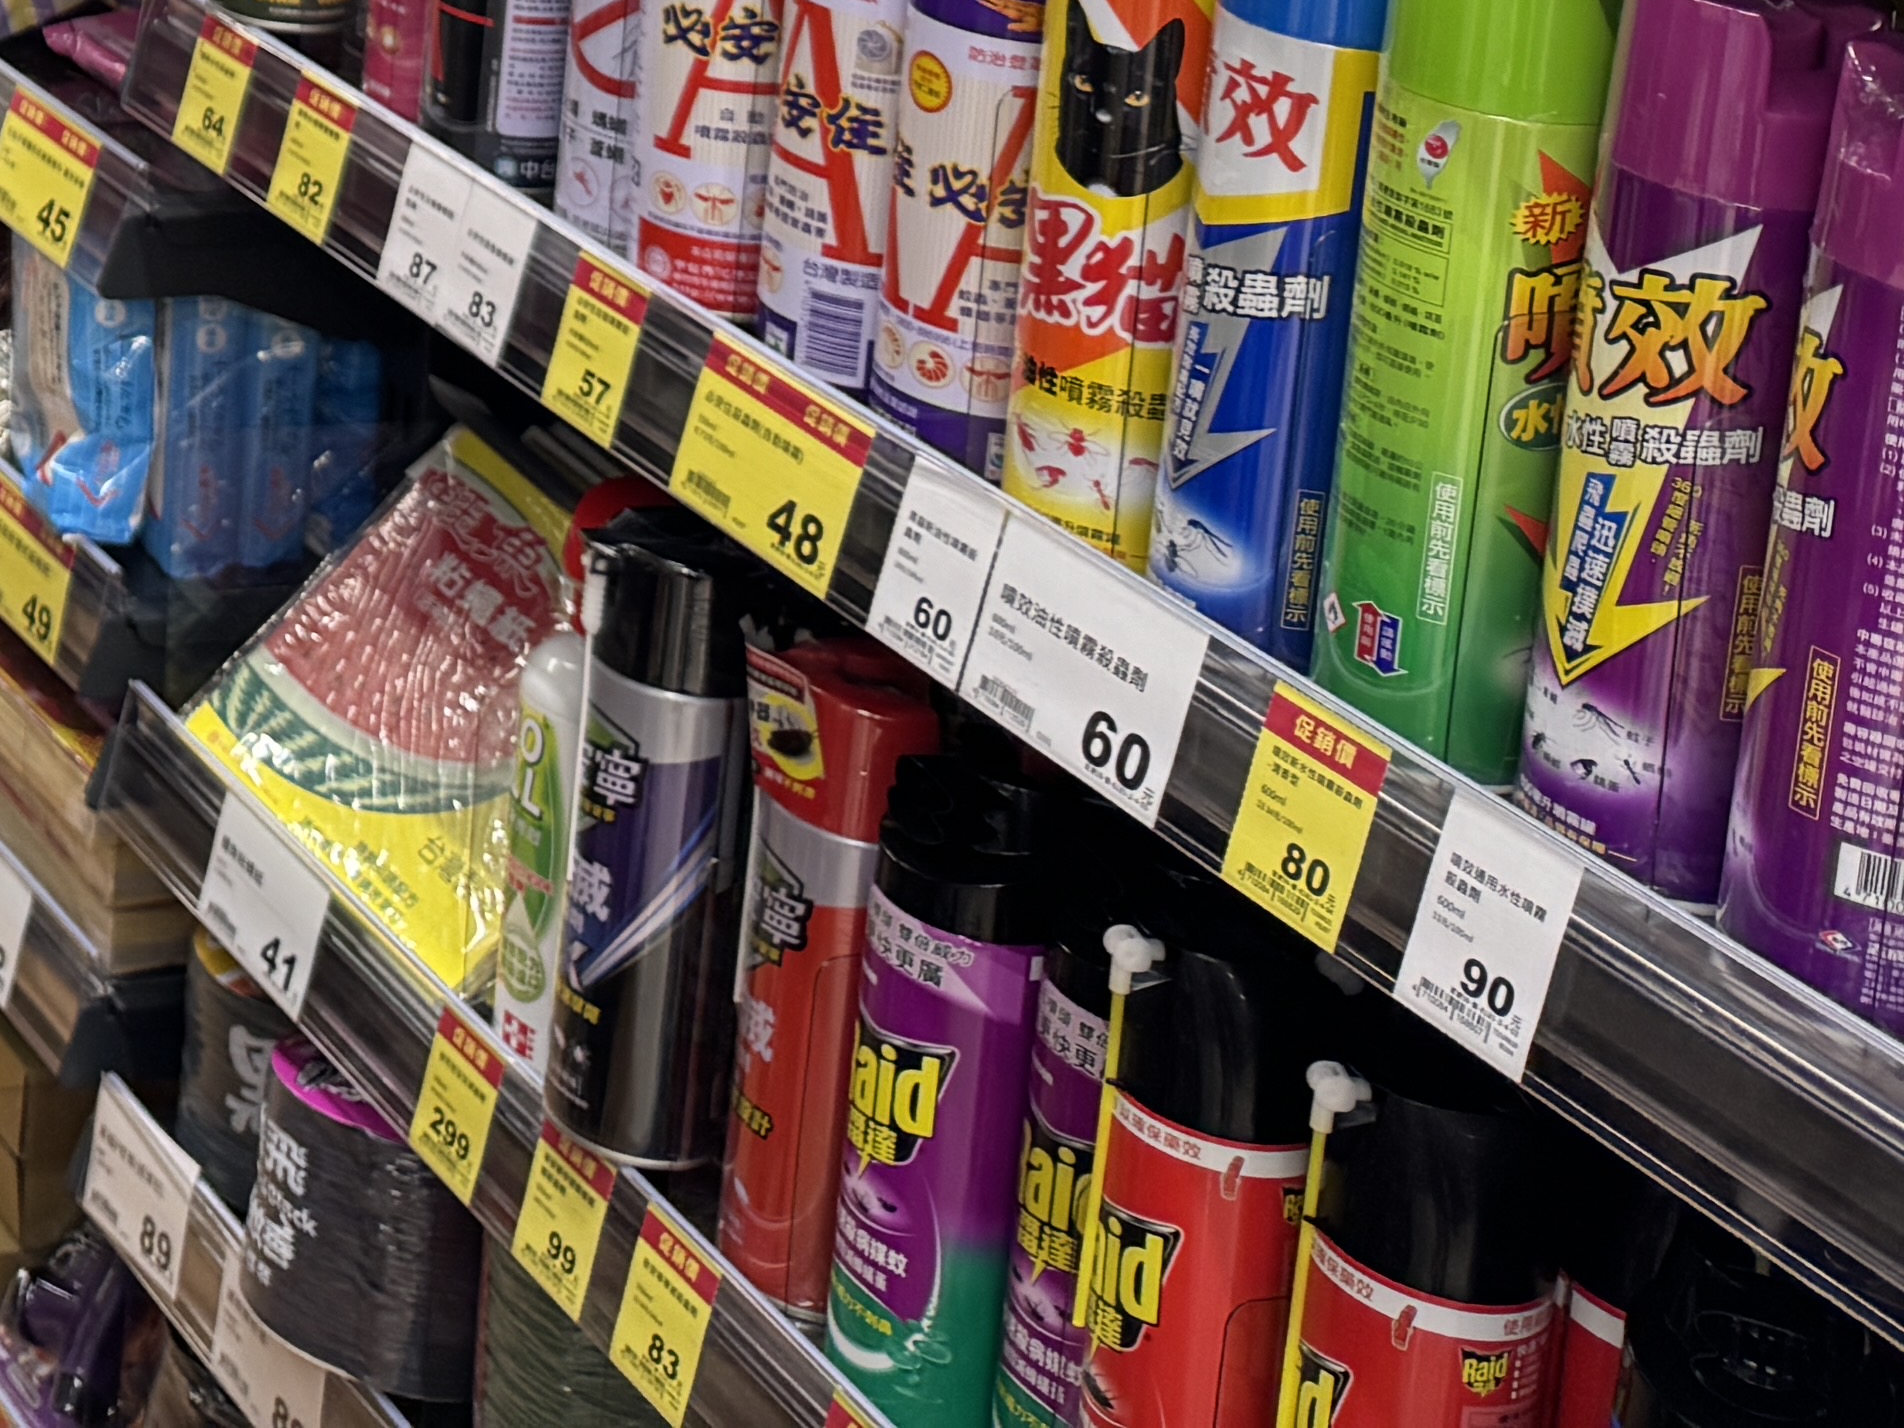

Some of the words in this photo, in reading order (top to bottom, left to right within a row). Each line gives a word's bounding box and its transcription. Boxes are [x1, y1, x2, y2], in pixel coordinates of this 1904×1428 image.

[201, 106, 225, 138] 64
[297, 171, 324, 209] 82
[36, 198, 71, 244] 45
[1522, 199, 1575, 239] 新
[408, 252, 438, 286] 87
[1204, 264, 1330, 321] 殺蟲劑
[468, 290, 497, 328] 83
[578, 368, 612, 406] 57
[1641, 425, 1764, 467] 殺蟲劑
[766, 499, 824, 566] 48
[1419, 481, 1458, 617] 使用前先看標示
[22, 595, 52, 644] 49
[913, 596, 953, 642] 60
[1081, 710, 1151, 791] 60
[1795, 656, 1836, 812] 使用前先看標示
[1280, 842, 1330, 897] 80
[260, 937, 297, 993] 41
[1460, 958, 1515, 1018] 90
[850, 1042, 942, 1139] aid
[428, 1105, 472, 1162] 299
[546, 1230, 577, 1275] 99
[647, 1333, 680, 1381] 83
[1463, 1352, 1510, 1389] Raid
